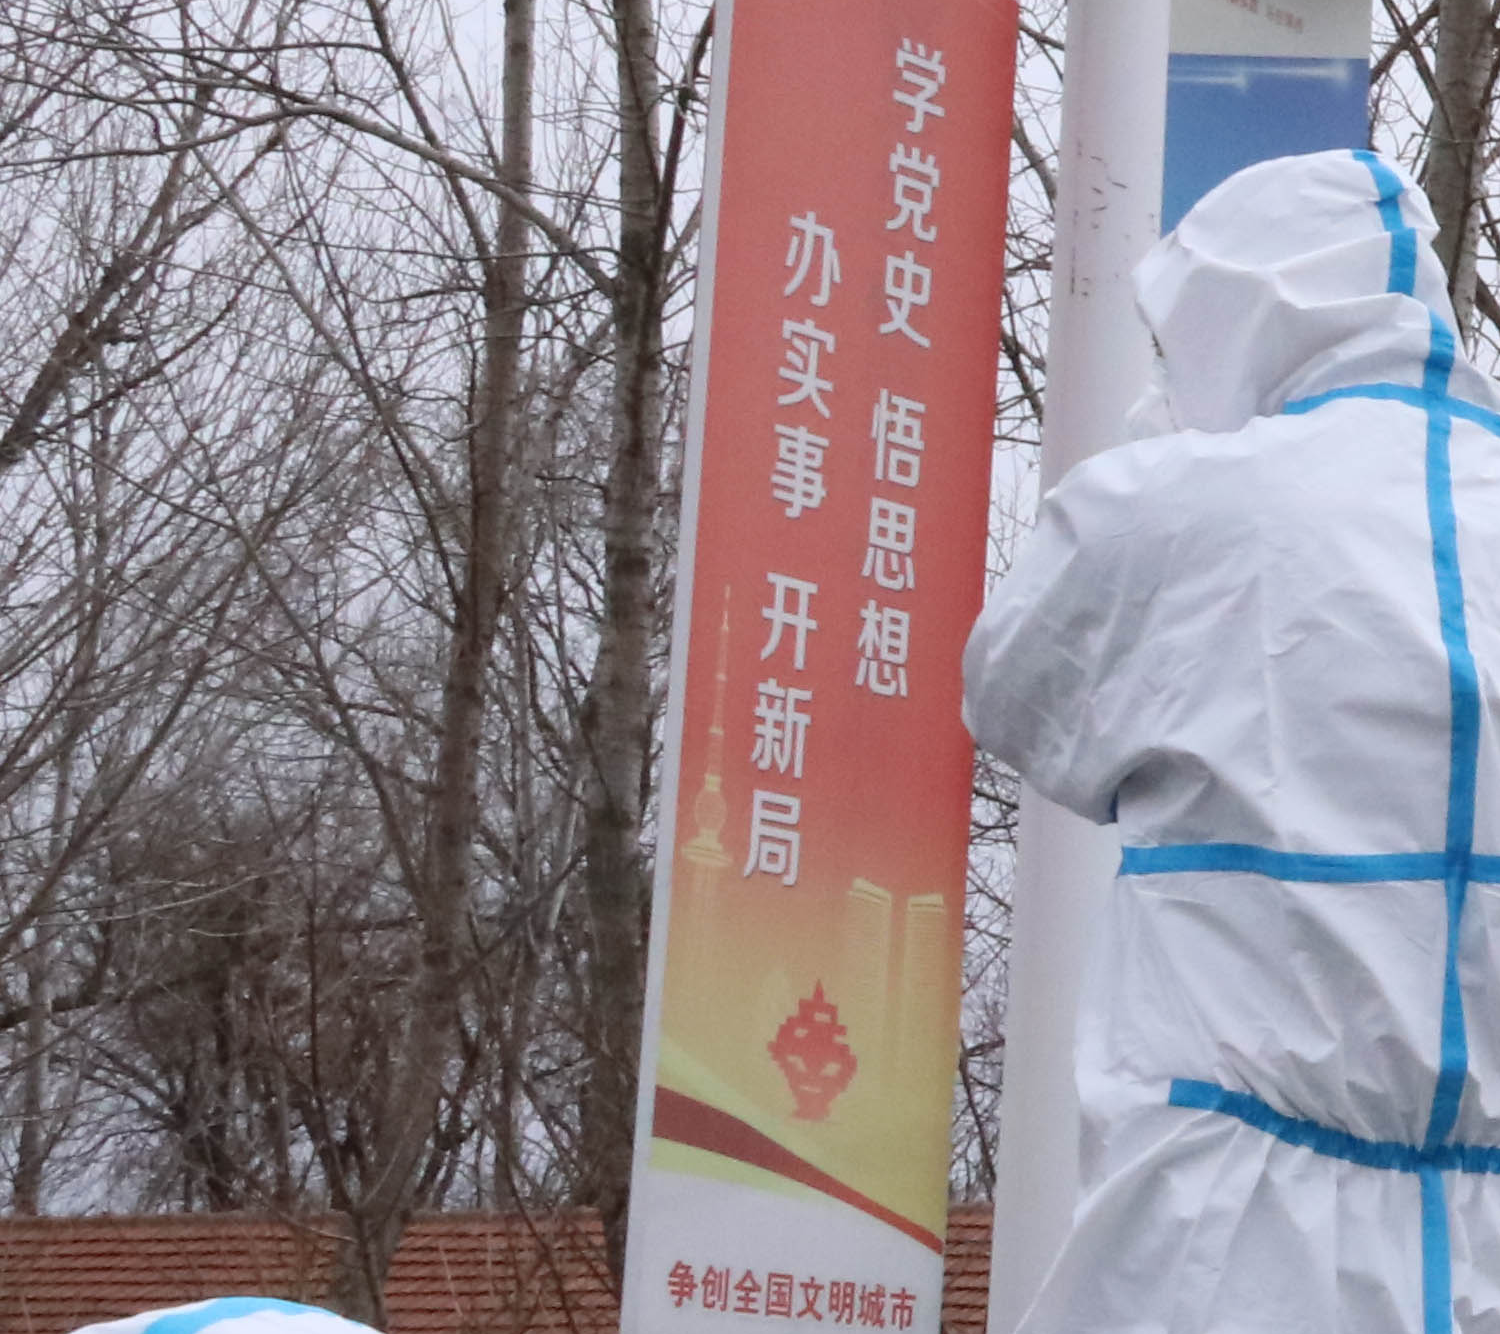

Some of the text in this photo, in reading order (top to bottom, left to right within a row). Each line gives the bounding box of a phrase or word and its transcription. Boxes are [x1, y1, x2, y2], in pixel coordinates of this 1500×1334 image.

[743, 211, 841, 887] 办实事 开新局
[854, 37, 947, 699] 学党史 悟思想
[667, 1260, 917, 1331] 争创全国文明城市
